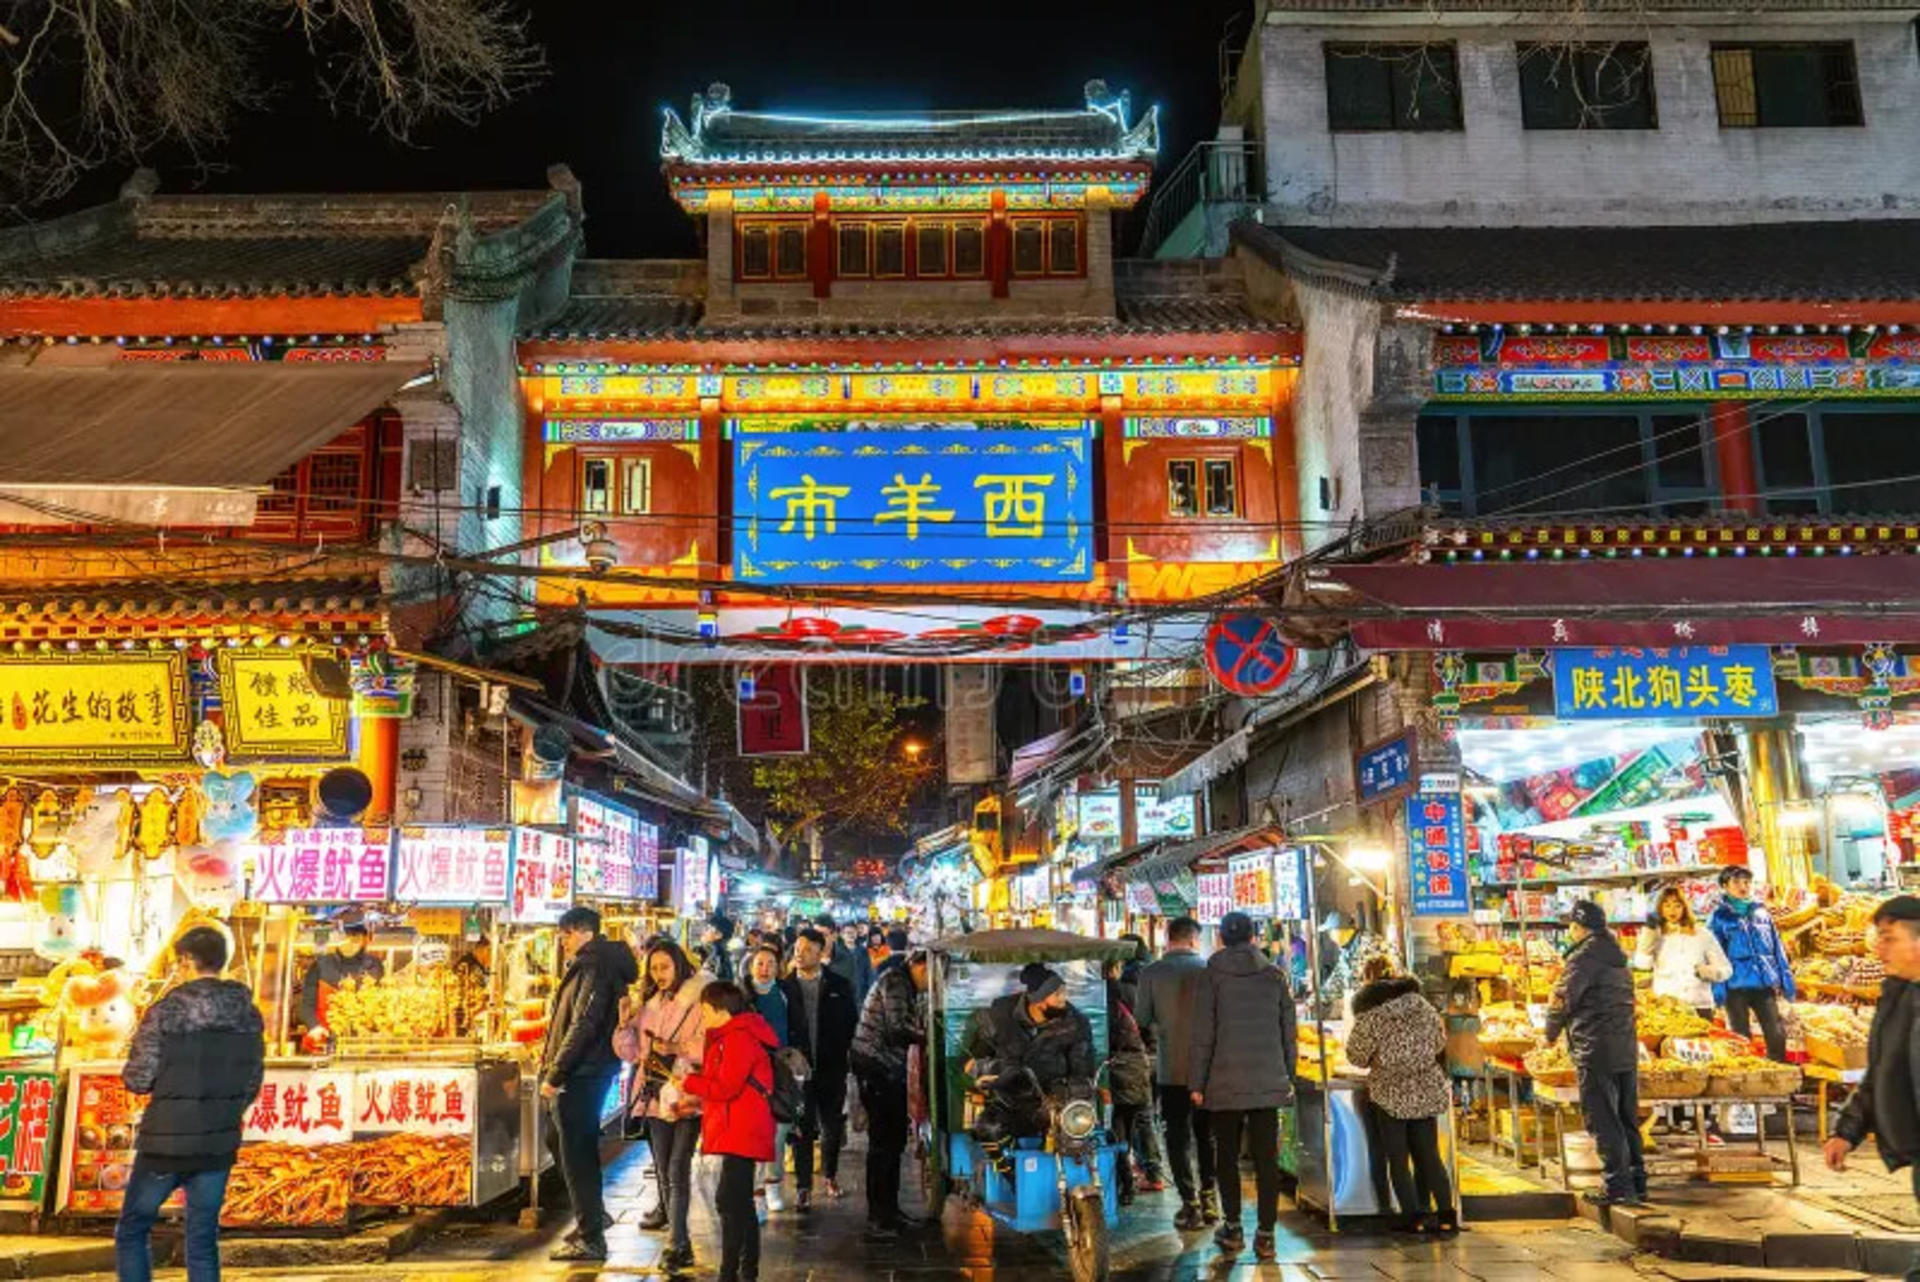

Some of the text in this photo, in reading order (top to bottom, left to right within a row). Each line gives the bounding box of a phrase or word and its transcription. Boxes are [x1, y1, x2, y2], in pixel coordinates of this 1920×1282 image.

[1572, 662, 1757, 709] 陕北狗头枣
[256, 847, 387, 899] 火爆鱿鱼
[398, 847, 505, 897] 火爆鱿鱼
[240, 1083, 344, 1133] 爆鱿鱼
[361, 1080, 465, 1124] 火爆鱿鱼
